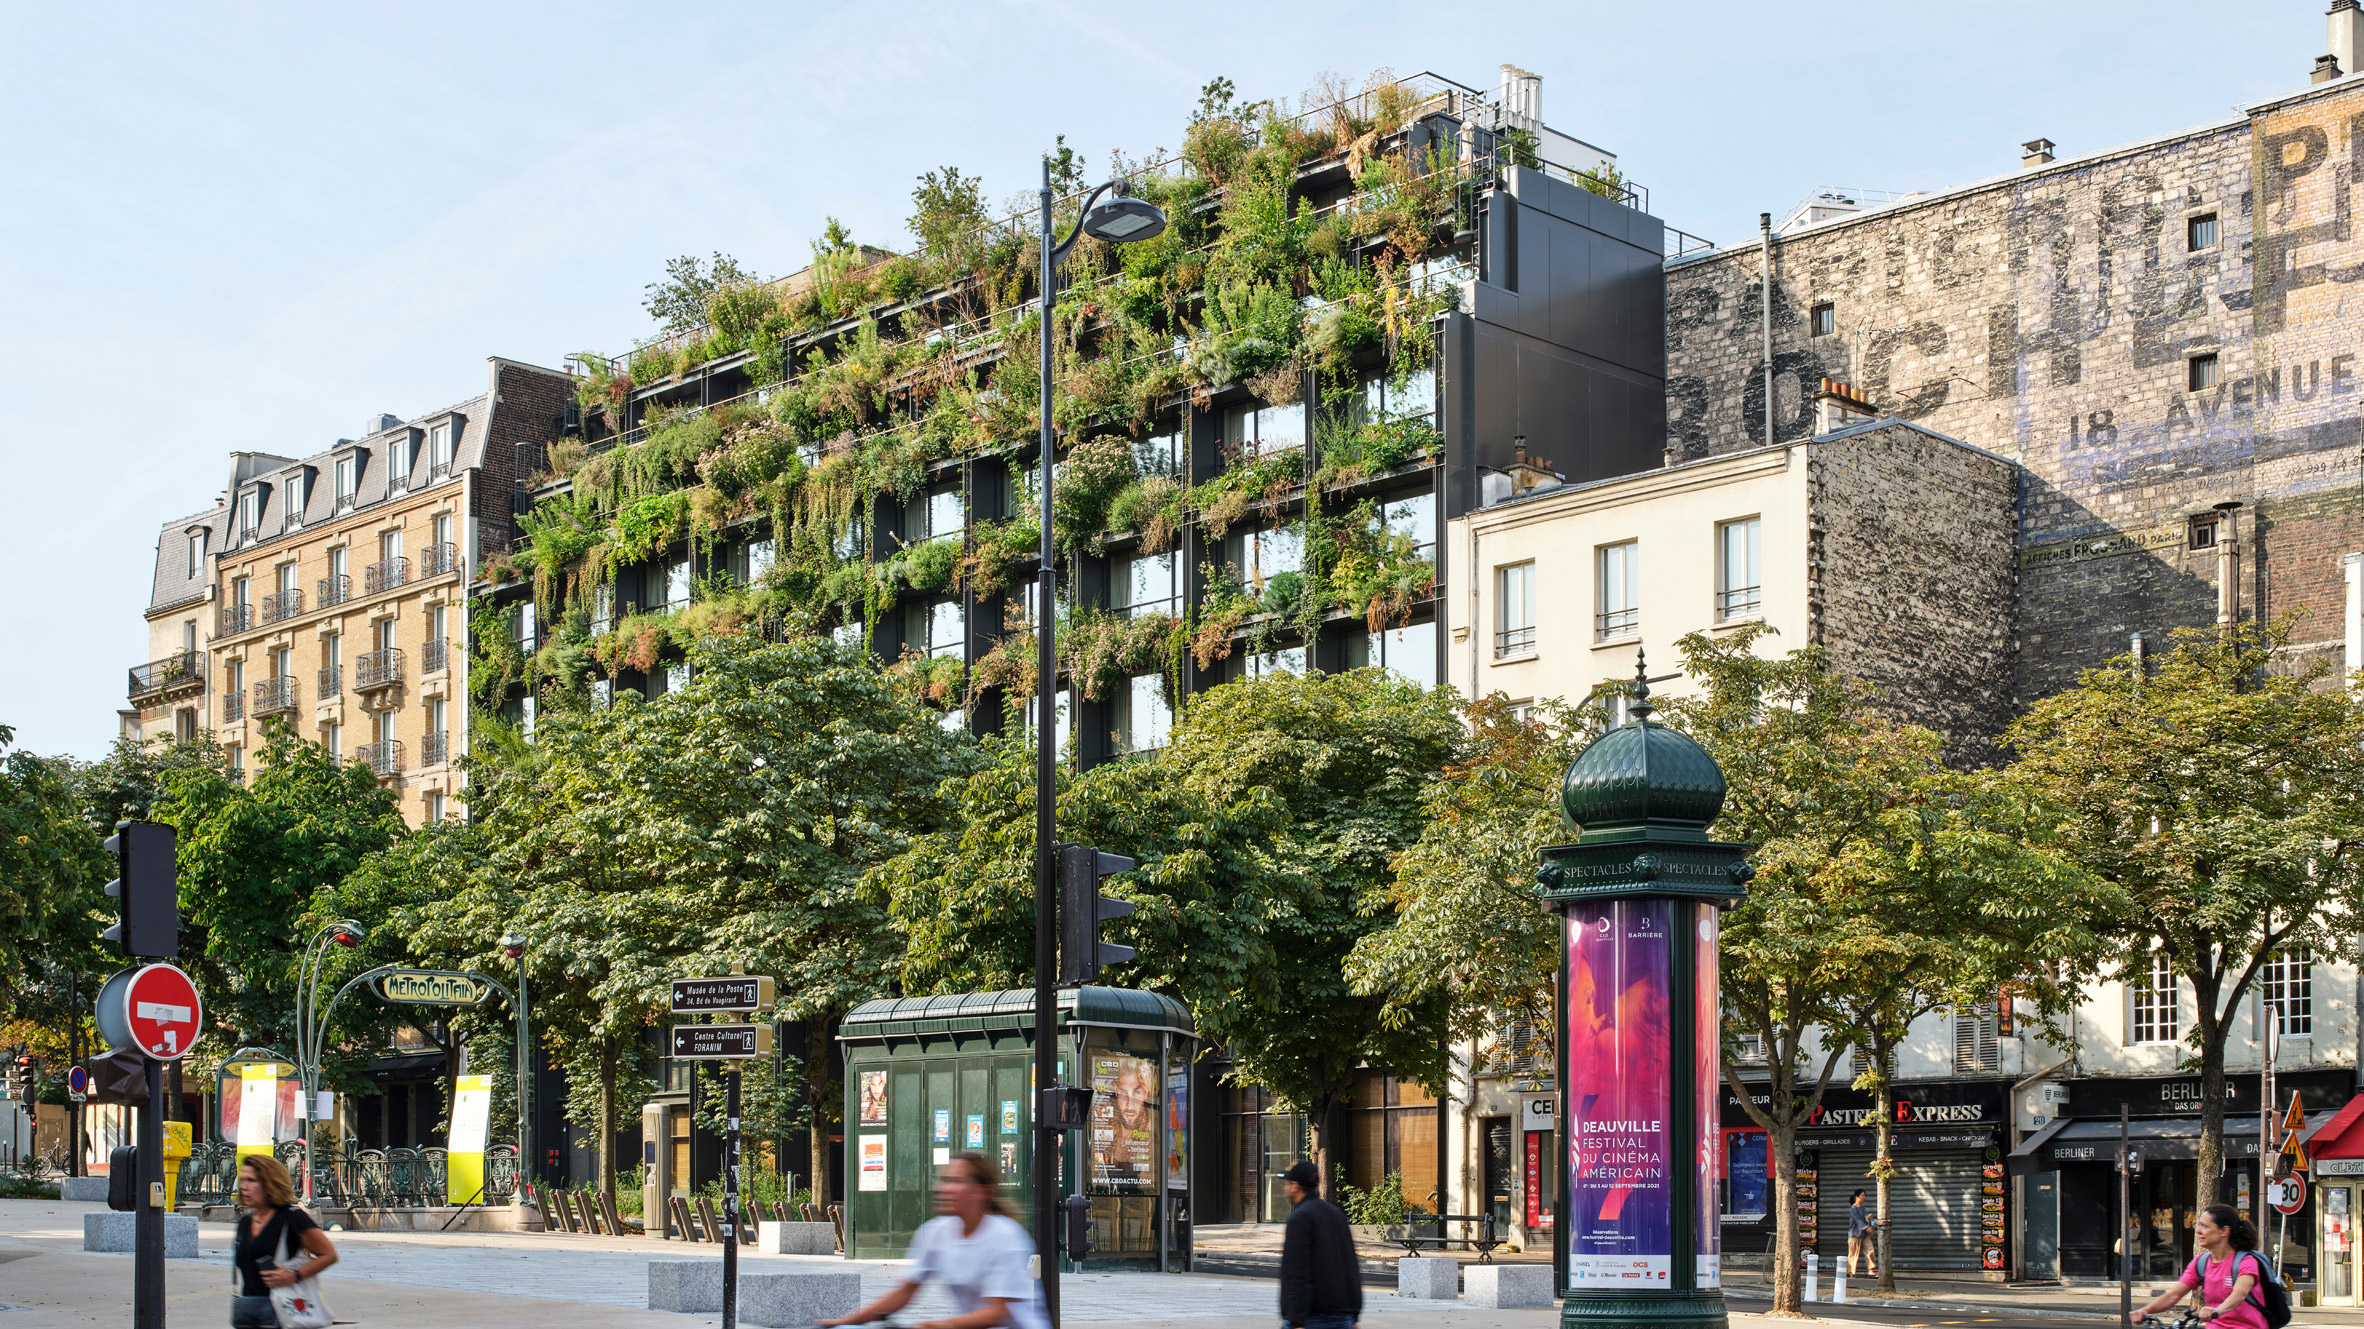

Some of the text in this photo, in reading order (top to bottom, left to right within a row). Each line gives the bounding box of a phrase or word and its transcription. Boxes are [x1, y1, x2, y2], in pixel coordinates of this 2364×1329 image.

[2070, 354, 2355, 451] 18 AVENUE
[1564, 863, 1632, 879] SPECTACLES
[1663, 862, 1728, 876] SPECTACLES
[687, 984, 744, 995] Musée de la Poste
[694, 1031, 743, 1041] Centre Culturel
[693, 1043, 722, 1052] FORANIM
[1729, 1095, 1770, 1105] PATEUR
[2174, 1101, 2189, 1111] DAS
[1896, 1101, 1983, 1123] EXPRESS
[1583, 1120, 1661, 1133] DEAUVILLE
[1583, 1137, 1646, 1149] FESTIVAL
[1918, 1135, 1937, 1143] KEBAB
[1583, 1151, 1661, 1164] DU CINÉMA
[2055, 1147, 2095, 1159] BERLINER
[1583, 1166, 1661, 1179] AMÉRICAIN
[2280, 1182, 2300, 1203] 30
